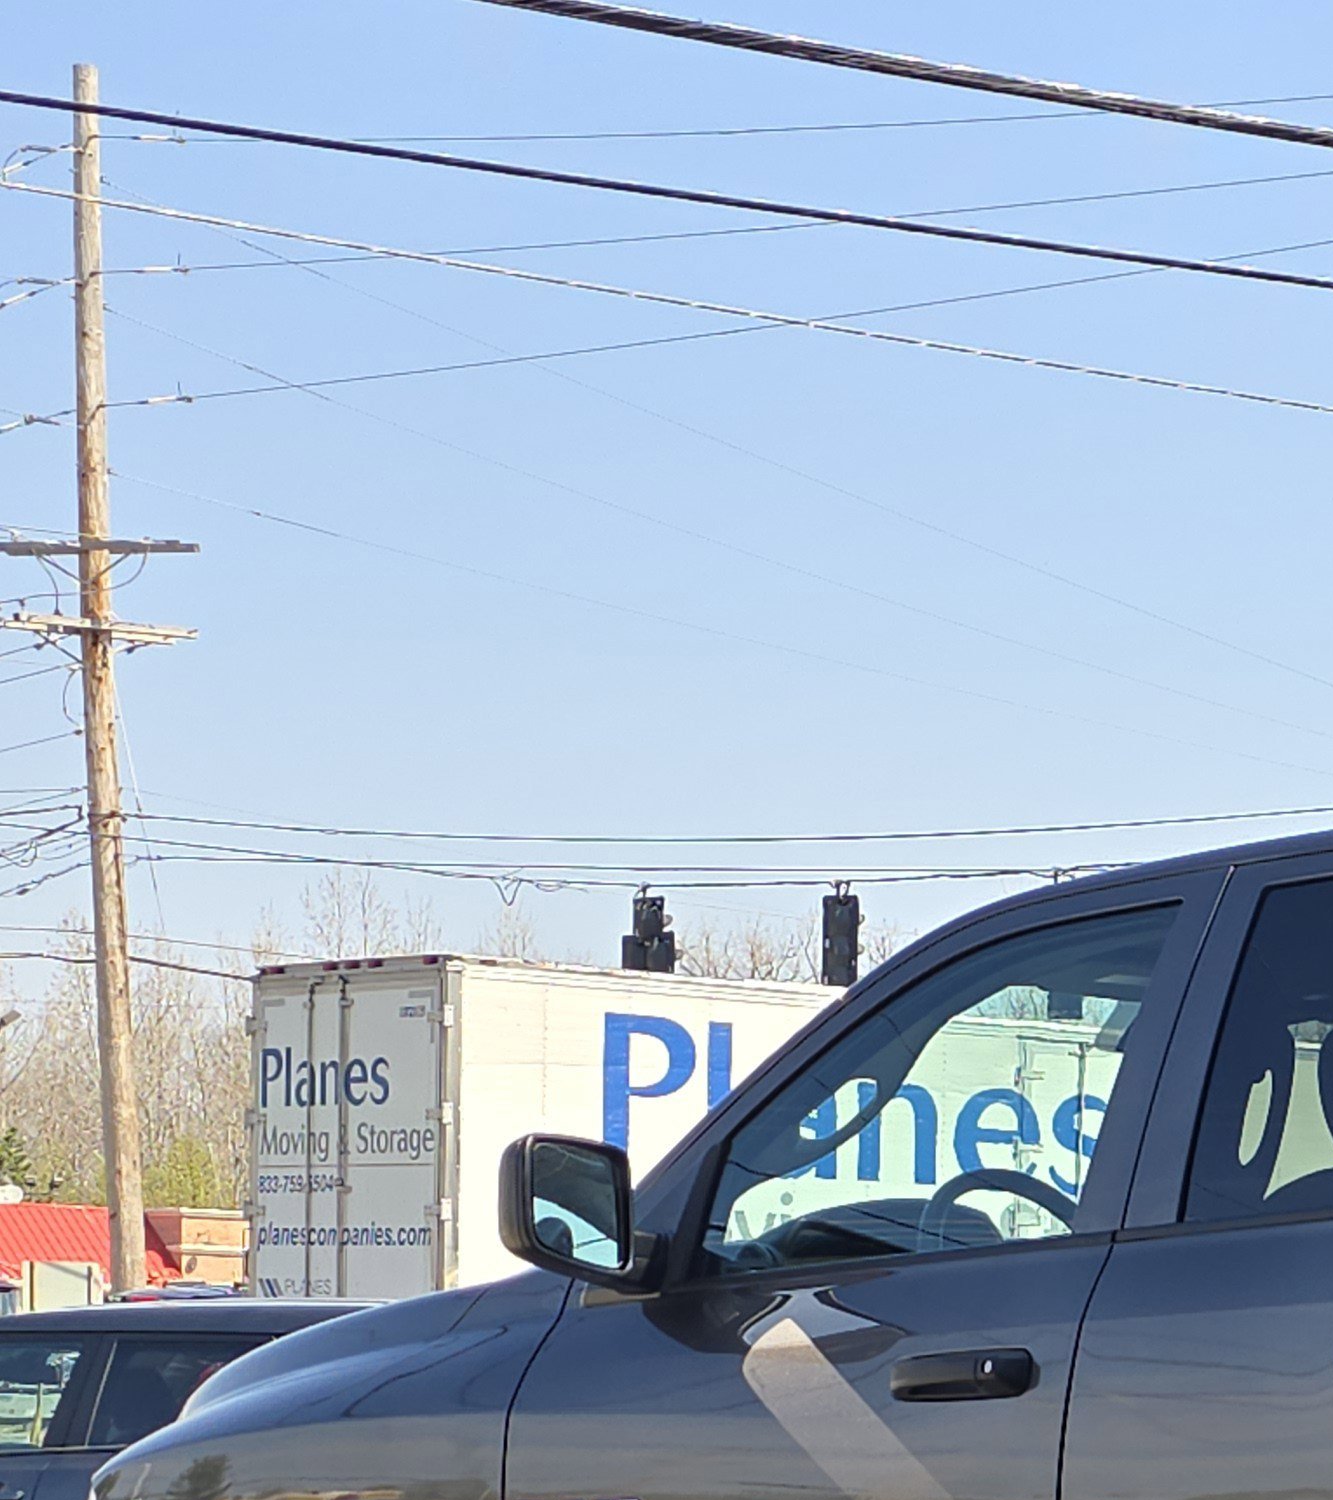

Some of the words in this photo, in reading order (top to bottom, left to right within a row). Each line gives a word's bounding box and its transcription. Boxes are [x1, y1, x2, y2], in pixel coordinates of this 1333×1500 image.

[261, 1047, 390, 1108] Planes
[260, 1124, 329, 1162] Moving
[356, 1122, 435, 1160] Storage
